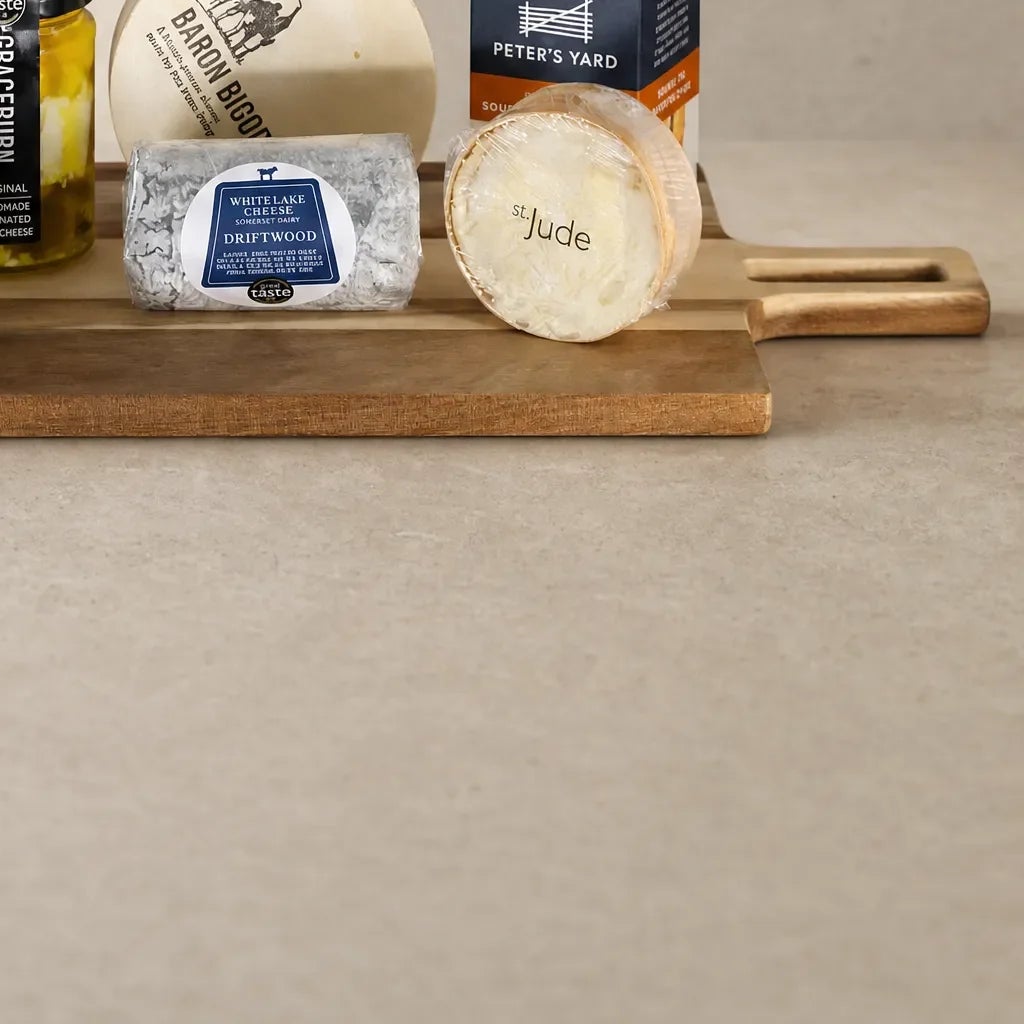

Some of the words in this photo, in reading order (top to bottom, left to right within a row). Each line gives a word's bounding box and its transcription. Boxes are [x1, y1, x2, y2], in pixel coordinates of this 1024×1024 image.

[170, 6, 232, 85] BARON
[493, 42, 563, 64] PETER'S
[568, 51, 618, 69] YARD
[229, 195, 271, 206] WHITE
[273, 194, 306, 205] LAKE
[244, 205, 294, 216] CHEESE
[277, 216, 301, 224] DAIRY
[0, 227, 34, 237] CHEESE
[511, 203, 530, 220] st.
[523, 207, 592, 251] Jude
[223, 230, 317, 245] DRIFTWOOD
[250, 288, 292, 298] taste
